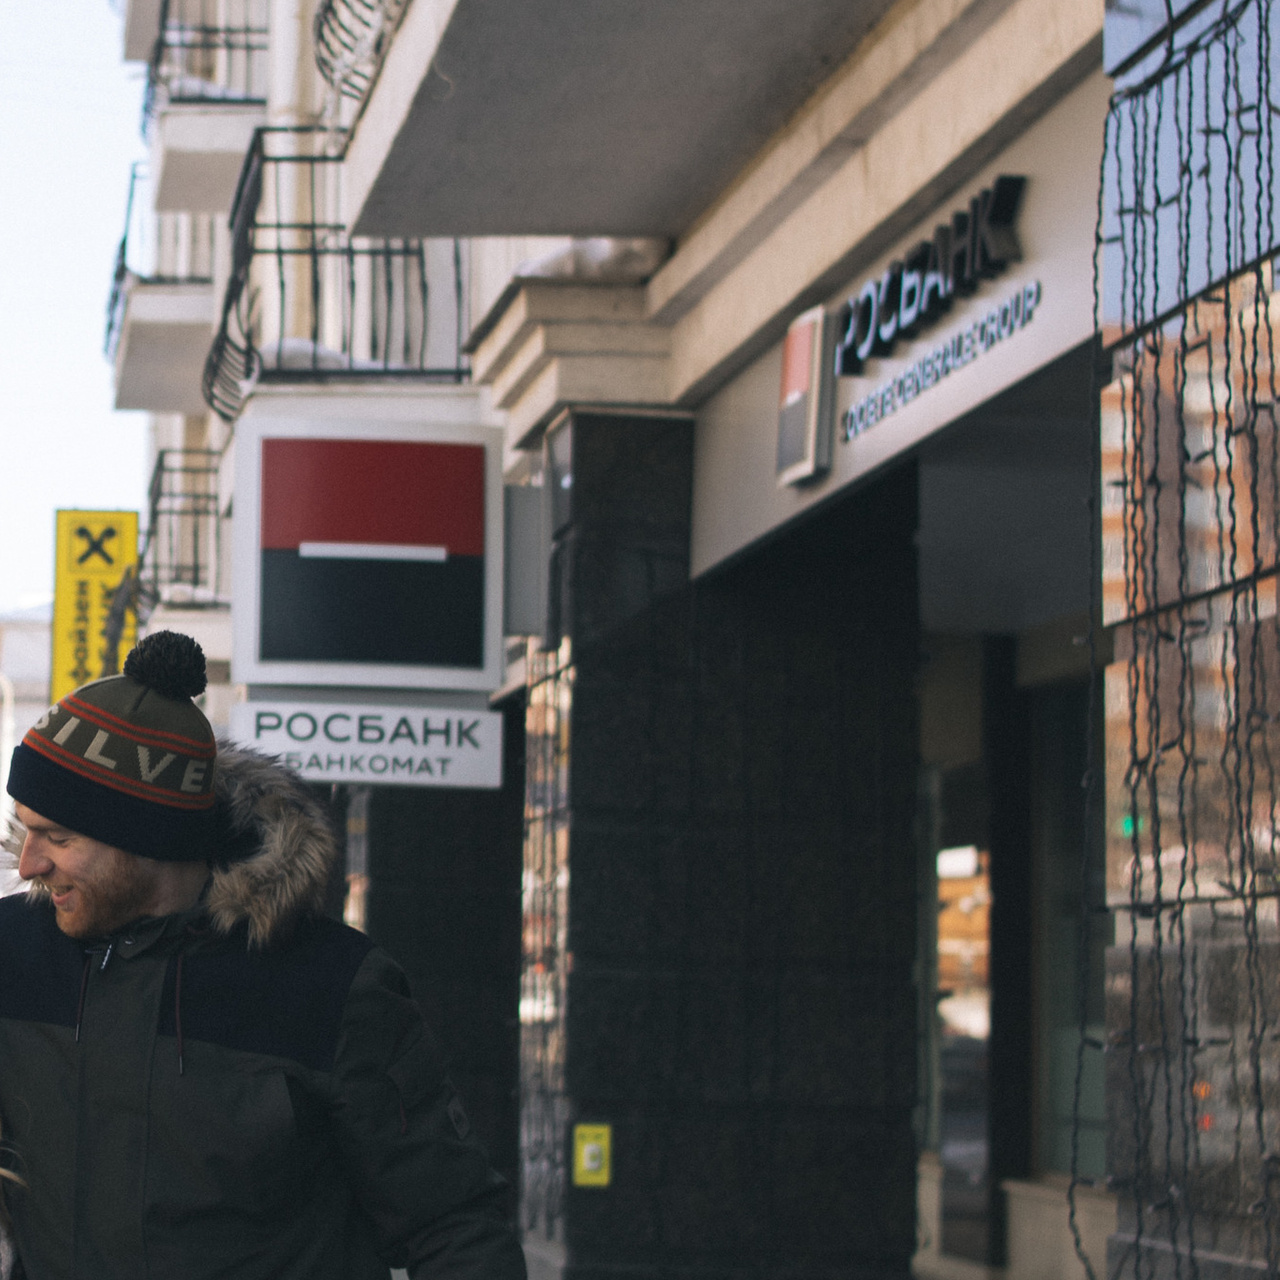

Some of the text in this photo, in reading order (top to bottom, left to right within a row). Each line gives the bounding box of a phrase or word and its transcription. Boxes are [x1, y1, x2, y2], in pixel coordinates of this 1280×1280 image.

[977, 279, 1042, 354] GROUP
[254, 711, 481, 750] РОСБАНК
[285, 751, 452, 777] БАНКОМАТ
